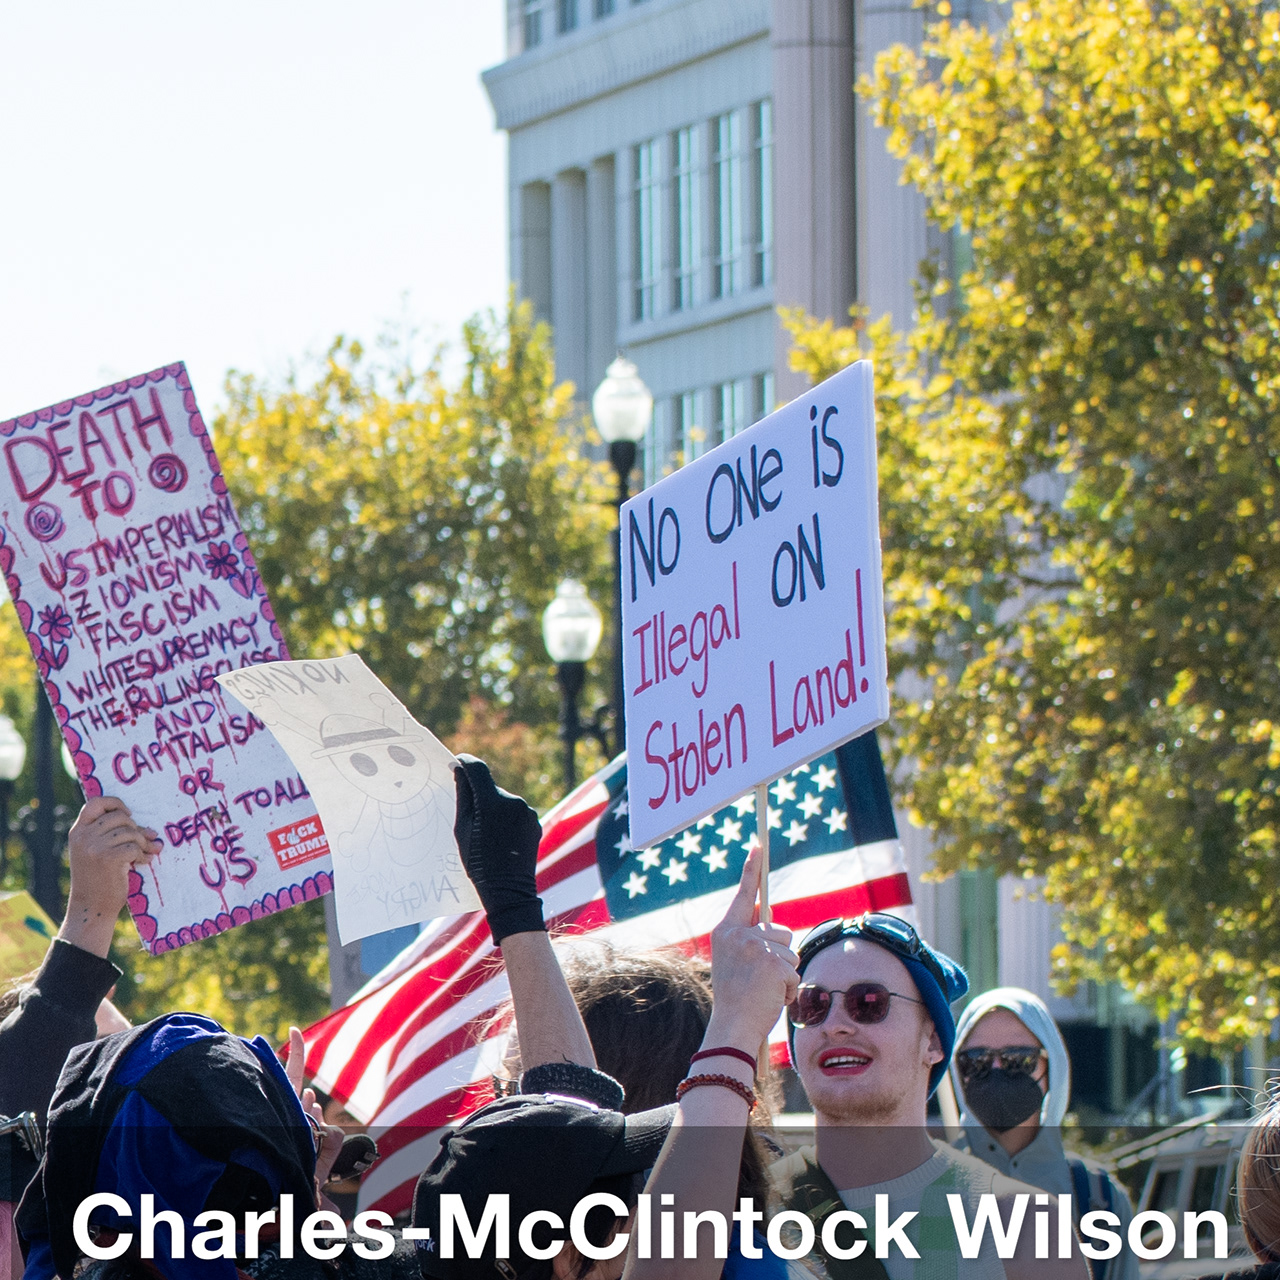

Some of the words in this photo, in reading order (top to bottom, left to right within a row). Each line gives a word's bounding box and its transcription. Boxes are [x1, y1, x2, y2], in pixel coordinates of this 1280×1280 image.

[2, 386, 174, 503] DEATH
[69, 470, 137, 522] TO
[68, 550, 208, 625] ZIONISM
[631, 560, 741, 699] Illegal
[771, 511, 826, 608] ON
[85, 583, 221, 653] FASCISM
[644, 702, 748, 810] Stolen
[768, 568, 870, 749] Land!
[154, 700, 216, 739] AND
[178, 766, 225, 796] OR
[164, 799, 232, 848] DEATH
[211, 825, 244, 855] OF
[277, 822, 318, 846] FCK
[198, 846, 258, 891] US
